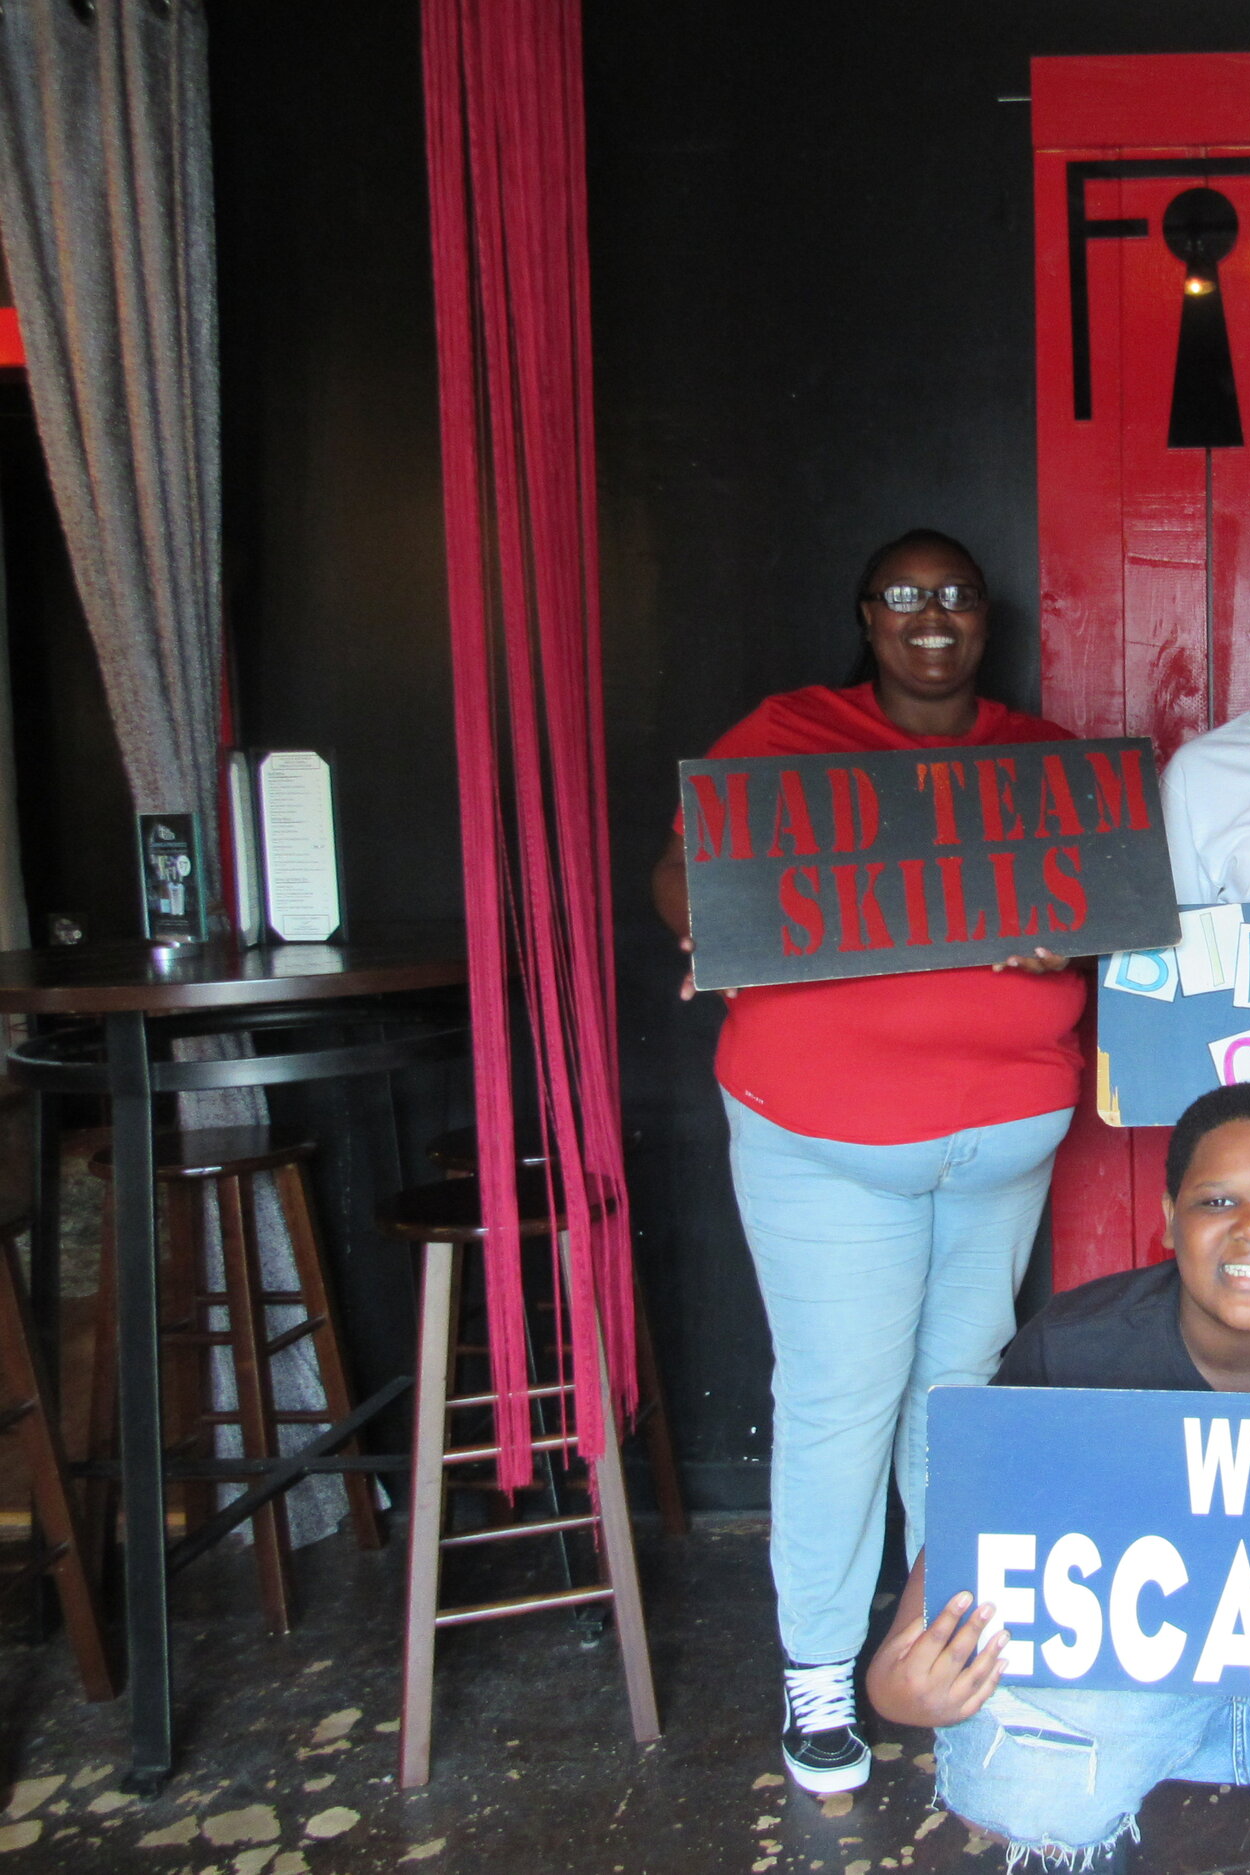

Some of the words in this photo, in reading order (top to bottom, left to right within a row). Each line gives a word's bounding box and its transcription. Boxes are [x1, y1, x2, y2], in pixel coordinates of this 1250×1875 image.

[688, 767, 880, 862] MAD
[916, 749, 1153, 846] TEAM
[778, 845, 1089, 957] SKILLS
